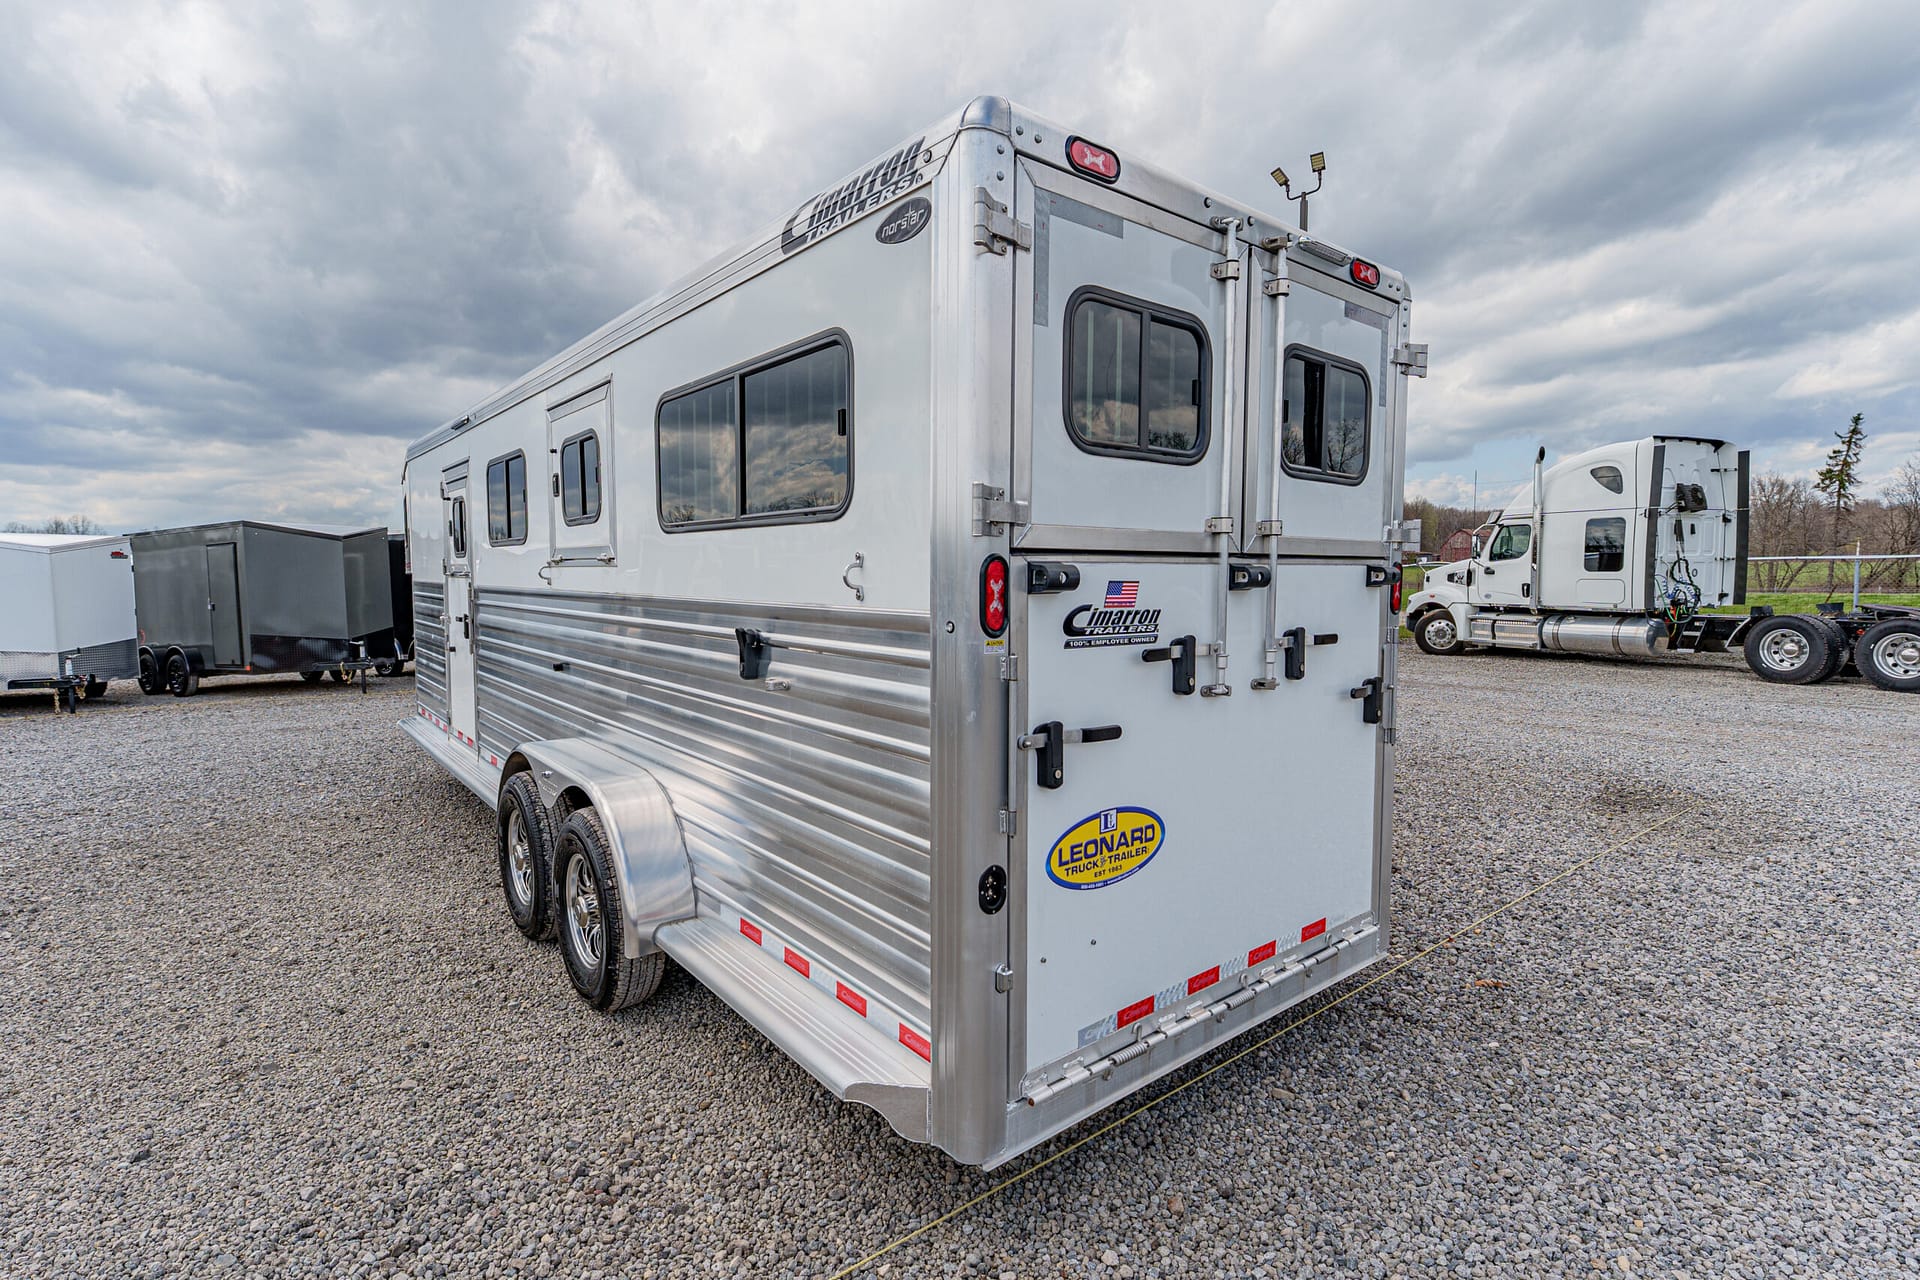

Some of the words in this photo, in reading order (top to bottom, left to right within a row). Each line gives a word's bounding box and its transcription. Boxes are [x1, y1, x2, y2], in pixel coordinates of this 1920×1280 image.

[781, 136, 926, 255] Cimarron
[806, 174, 912, 243] TRAILERS
[881, 204, 925, 238] norstar
[1063, 604, 1161, 637] Cimarron
[1084, 625, 1156, 635] TRAILERS
[1091, 638, 1129, 646] EMPLOYEE
[1058, 823, 1155, 867] LEONARD
[1065, 859, 1099, 877] TRUCK
[1107, 846, 1148, 864] TRAILER
[1094, 869, 1106, 878] EST
